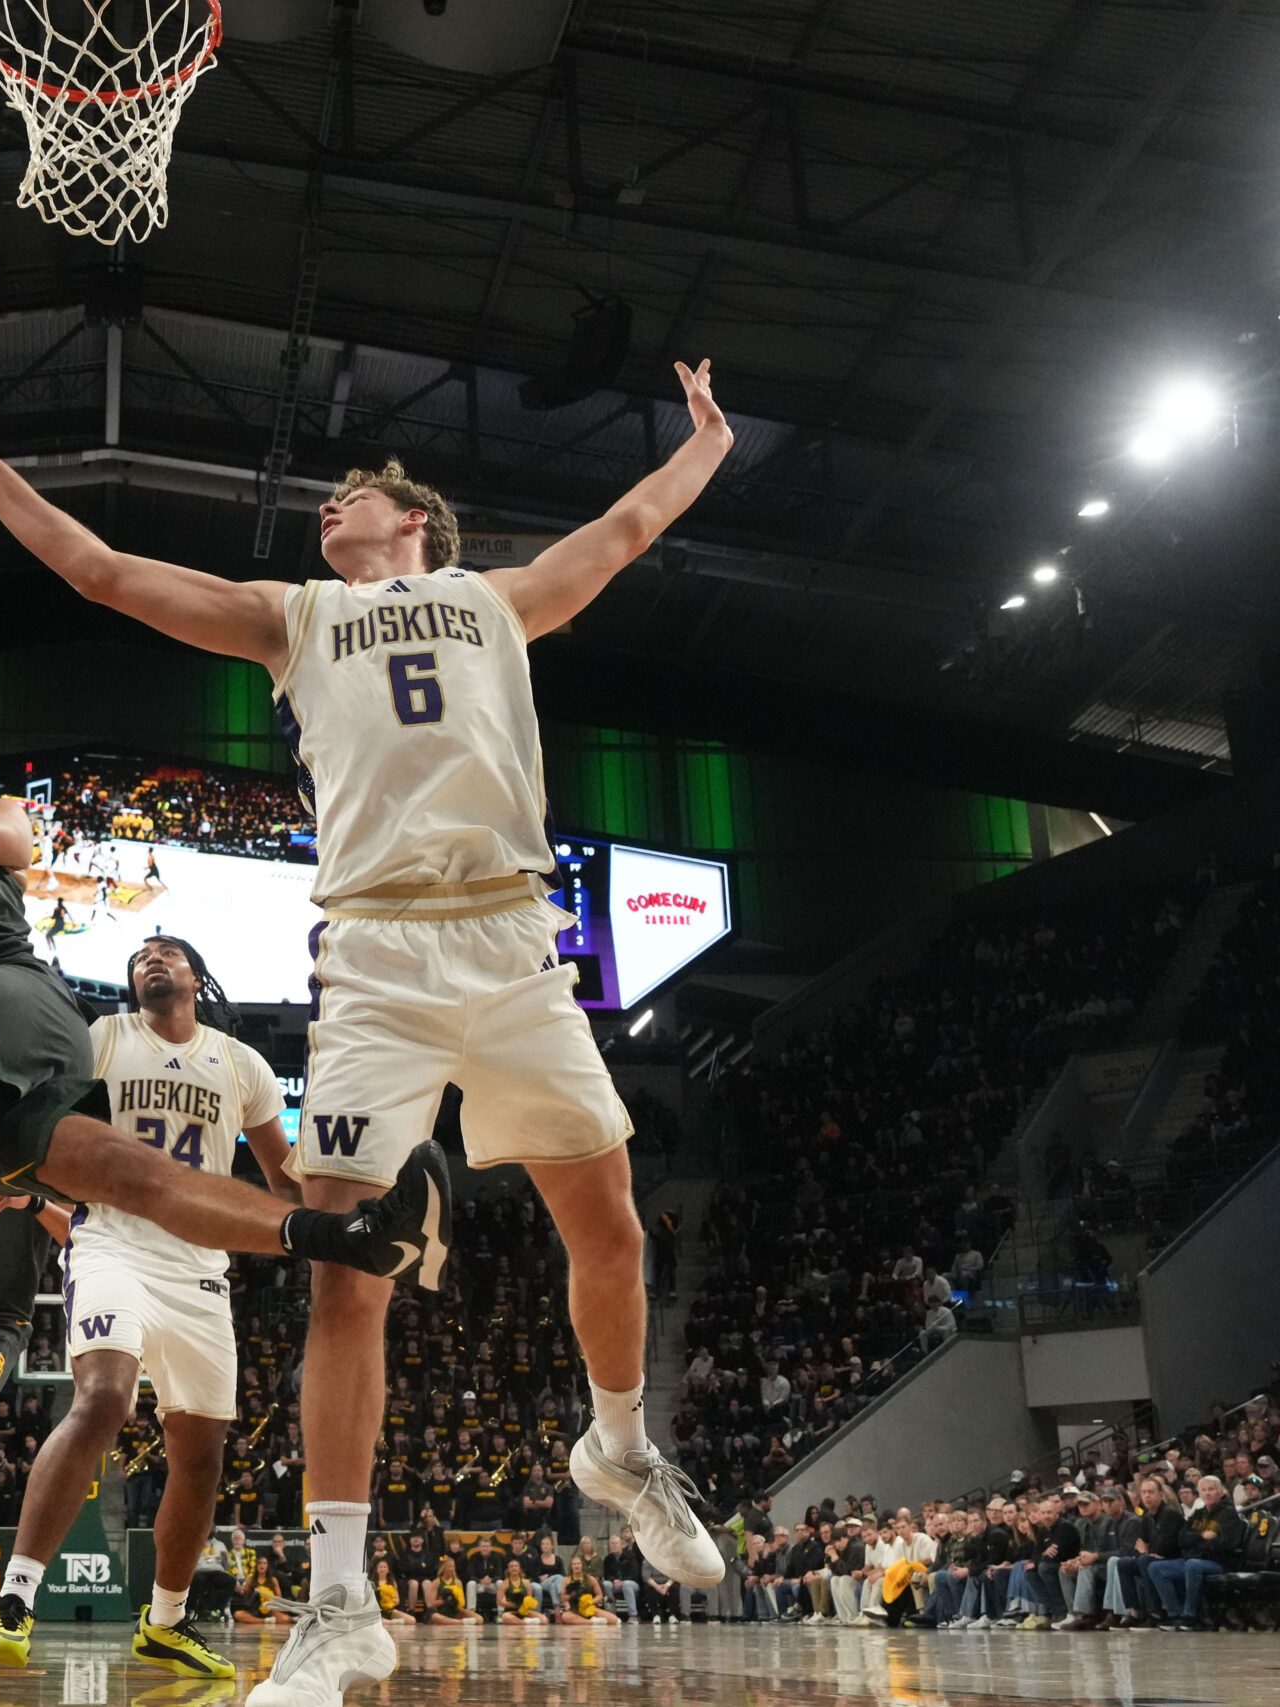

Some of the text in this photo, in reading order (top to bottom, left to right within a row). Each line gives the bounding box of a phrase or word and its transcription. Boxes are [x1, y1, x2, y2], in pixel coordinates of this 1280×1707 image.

[330, 600, 484, 664] HUSKIES
[386, 650, 447, 728] 6
[574, 878, 582, 888] 3
[574, 893, 582, 903] 2
[575, 906, 582, 916] 1
[576, 920, 583, 930] 1
[576, 936, 584, 946] 3
[118, 1078, 222, 1125] HUSKIES
[135, 1116, 204, 1169] 24
[312, 1113, 370, 1158] W
[79, 1314, 116, 1341] W
[47, 1583, 123, 1594] Your Bank for Life
